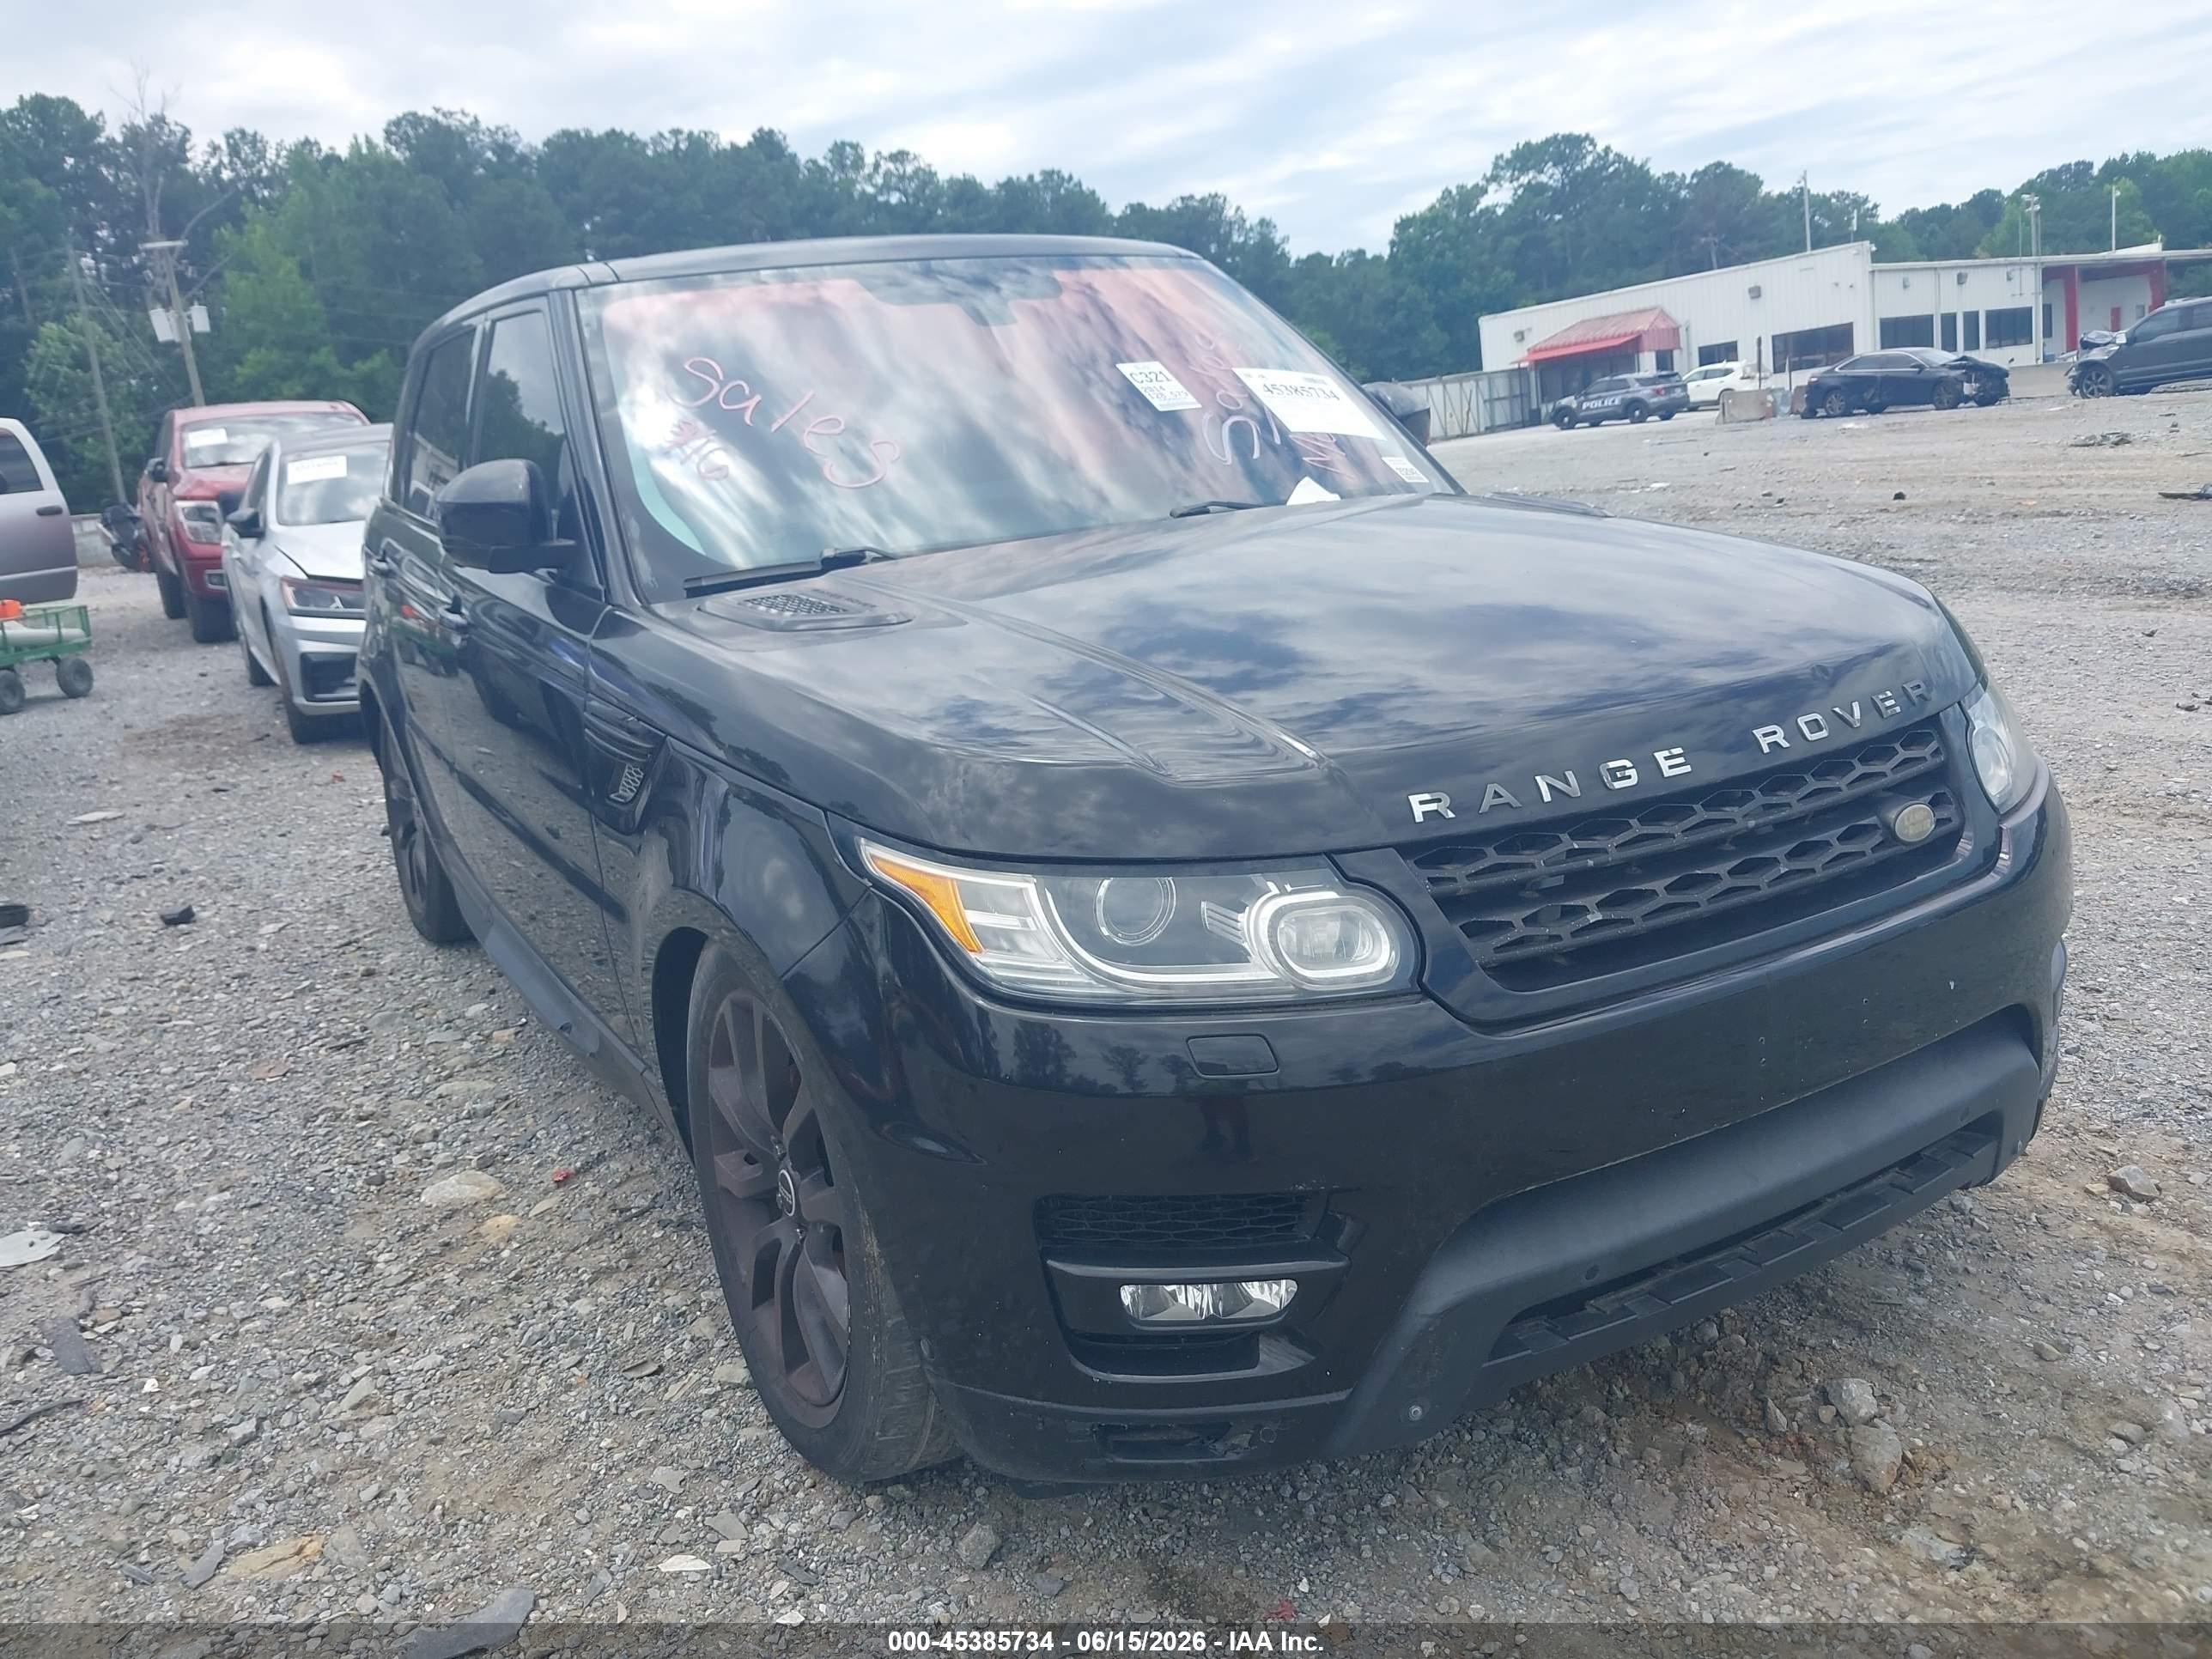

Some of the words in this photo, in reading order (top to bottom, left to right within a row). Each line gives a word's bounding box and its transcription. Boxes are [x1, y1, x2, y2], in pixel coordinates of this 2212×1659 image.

[1129, 370, 1173, 384] C321
[1262, 383, 1340, 402] 45385734
[1582, 396, 1621, 410] POLICE
[666, 357, 901, 489] Sales
[1407, 747, 1692, 823] RANGE
[1752, 679, 1932, 755] ROVER
